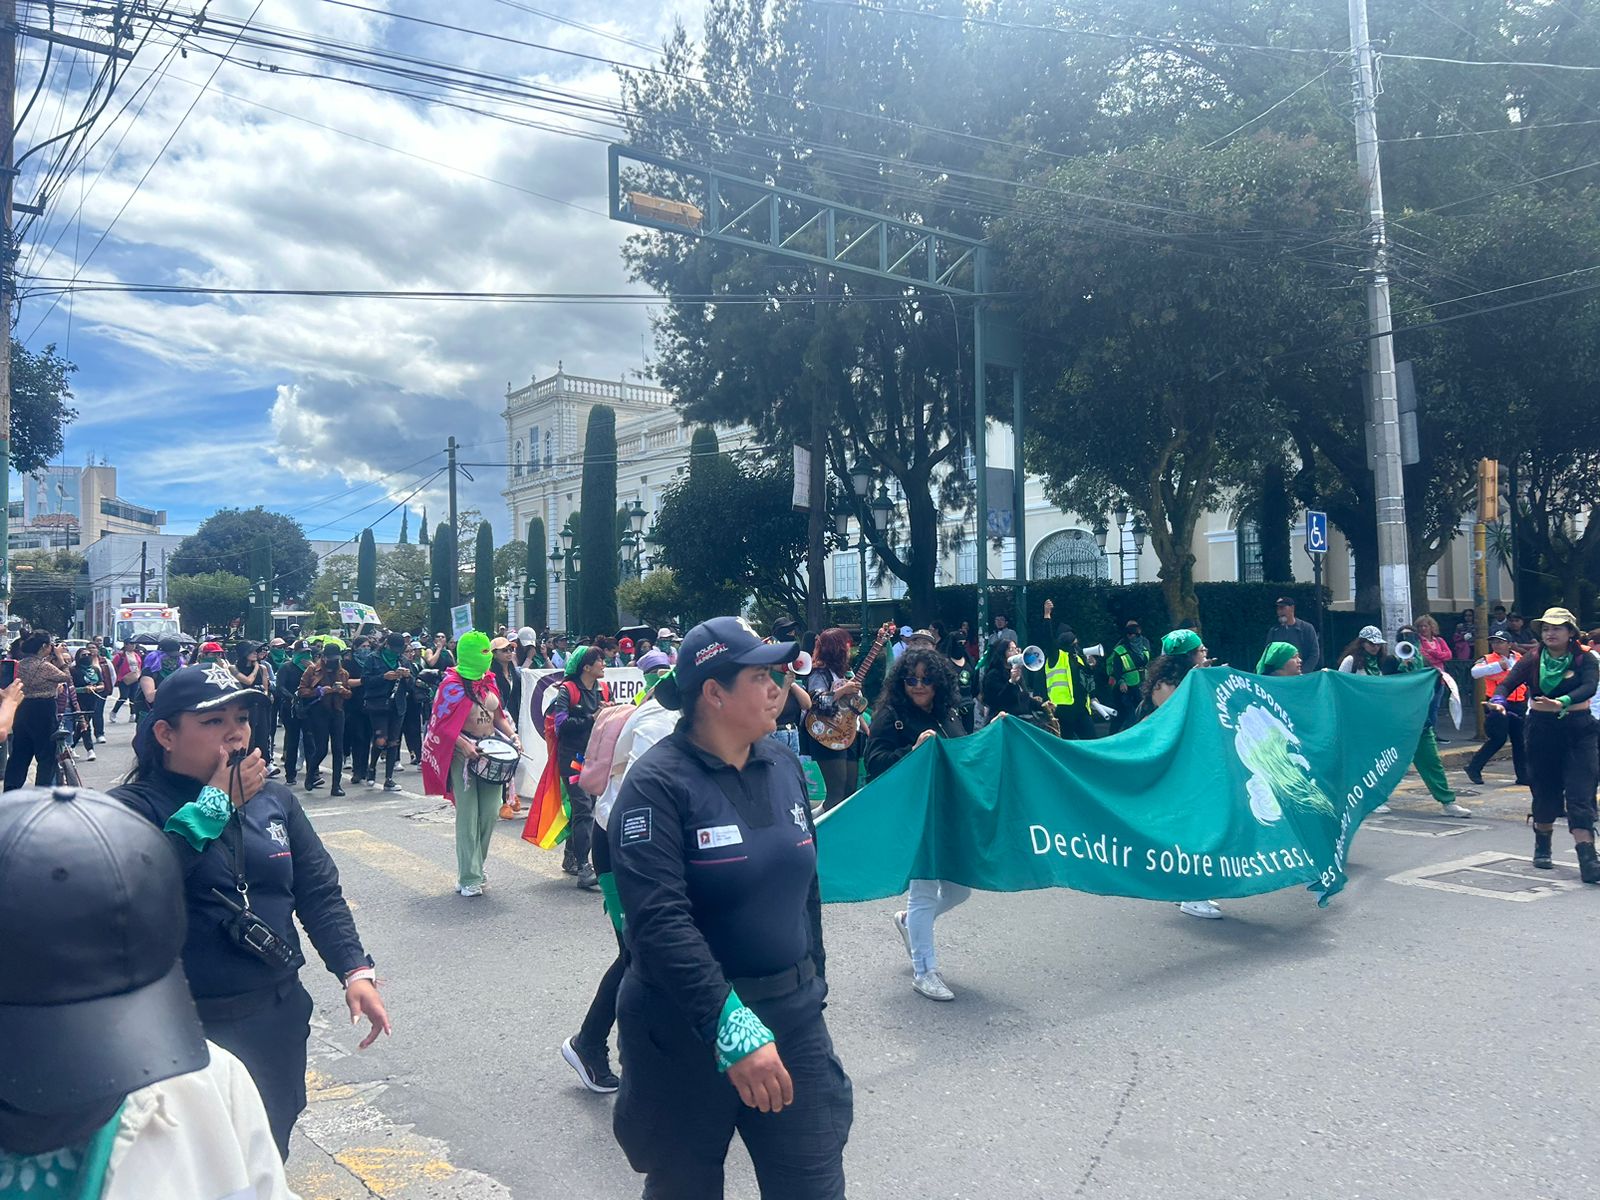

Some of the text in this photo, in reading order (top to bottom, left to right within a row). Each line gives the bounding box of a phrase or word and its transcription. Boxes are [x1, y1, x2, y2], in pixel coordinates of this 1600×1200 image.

[1224, 674, 1253, 693] VERDE
[1254, 683, 1295, 732] EDOMEX
[1347, 785, 1364, 808] no
[1375, 746, 1399, 777] delito
[1029, 824, 1133, 868] Decidir
[1146, 846, 1213, 877] sobre
[1219, 847, 1304, 878] nuestras
